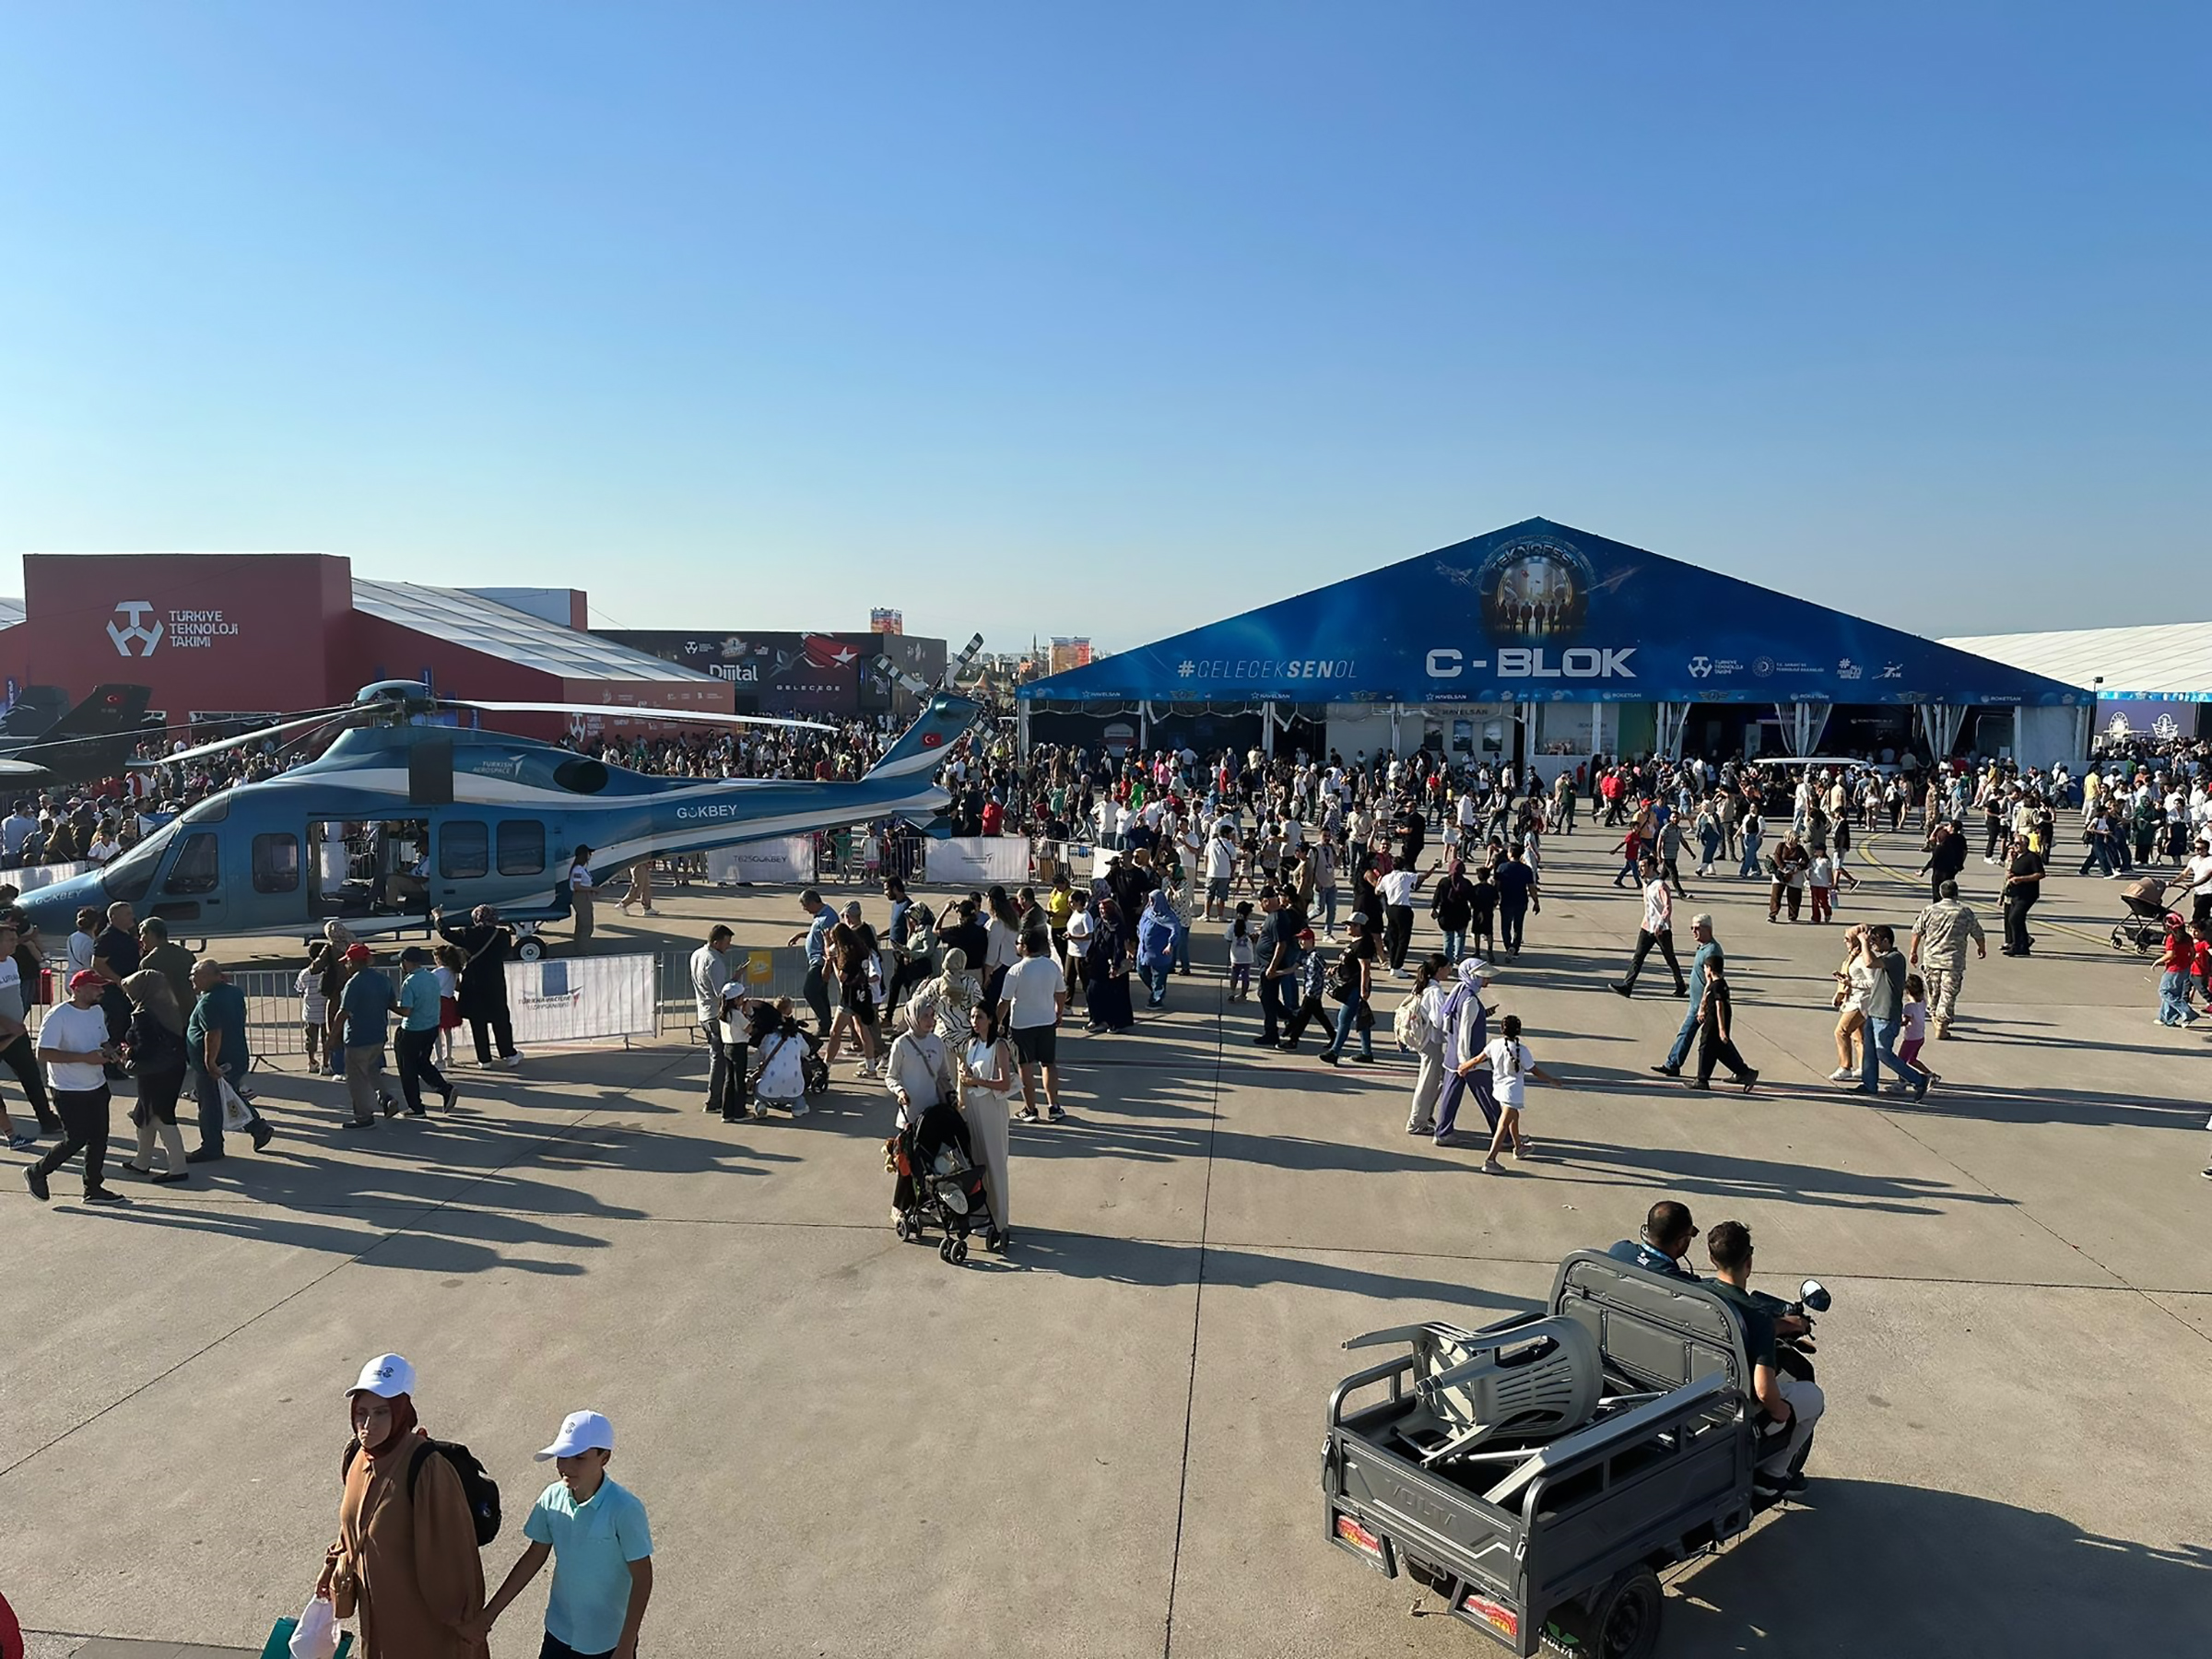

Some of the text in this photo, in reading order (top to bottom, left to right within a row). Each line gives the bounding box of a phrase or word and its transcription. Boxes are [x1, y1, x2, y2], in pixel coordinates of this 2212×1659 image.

[169, 609, 223, 622] TÜRKİYE
[169, 623, 239, 635] TEKNOLOJİ
[170, 636, 211, 647] TAKIMI
[1177, 660, 1358, 678] #GELECEKSENOL
[1384, 1477, 1461, 1530] VOLTA
